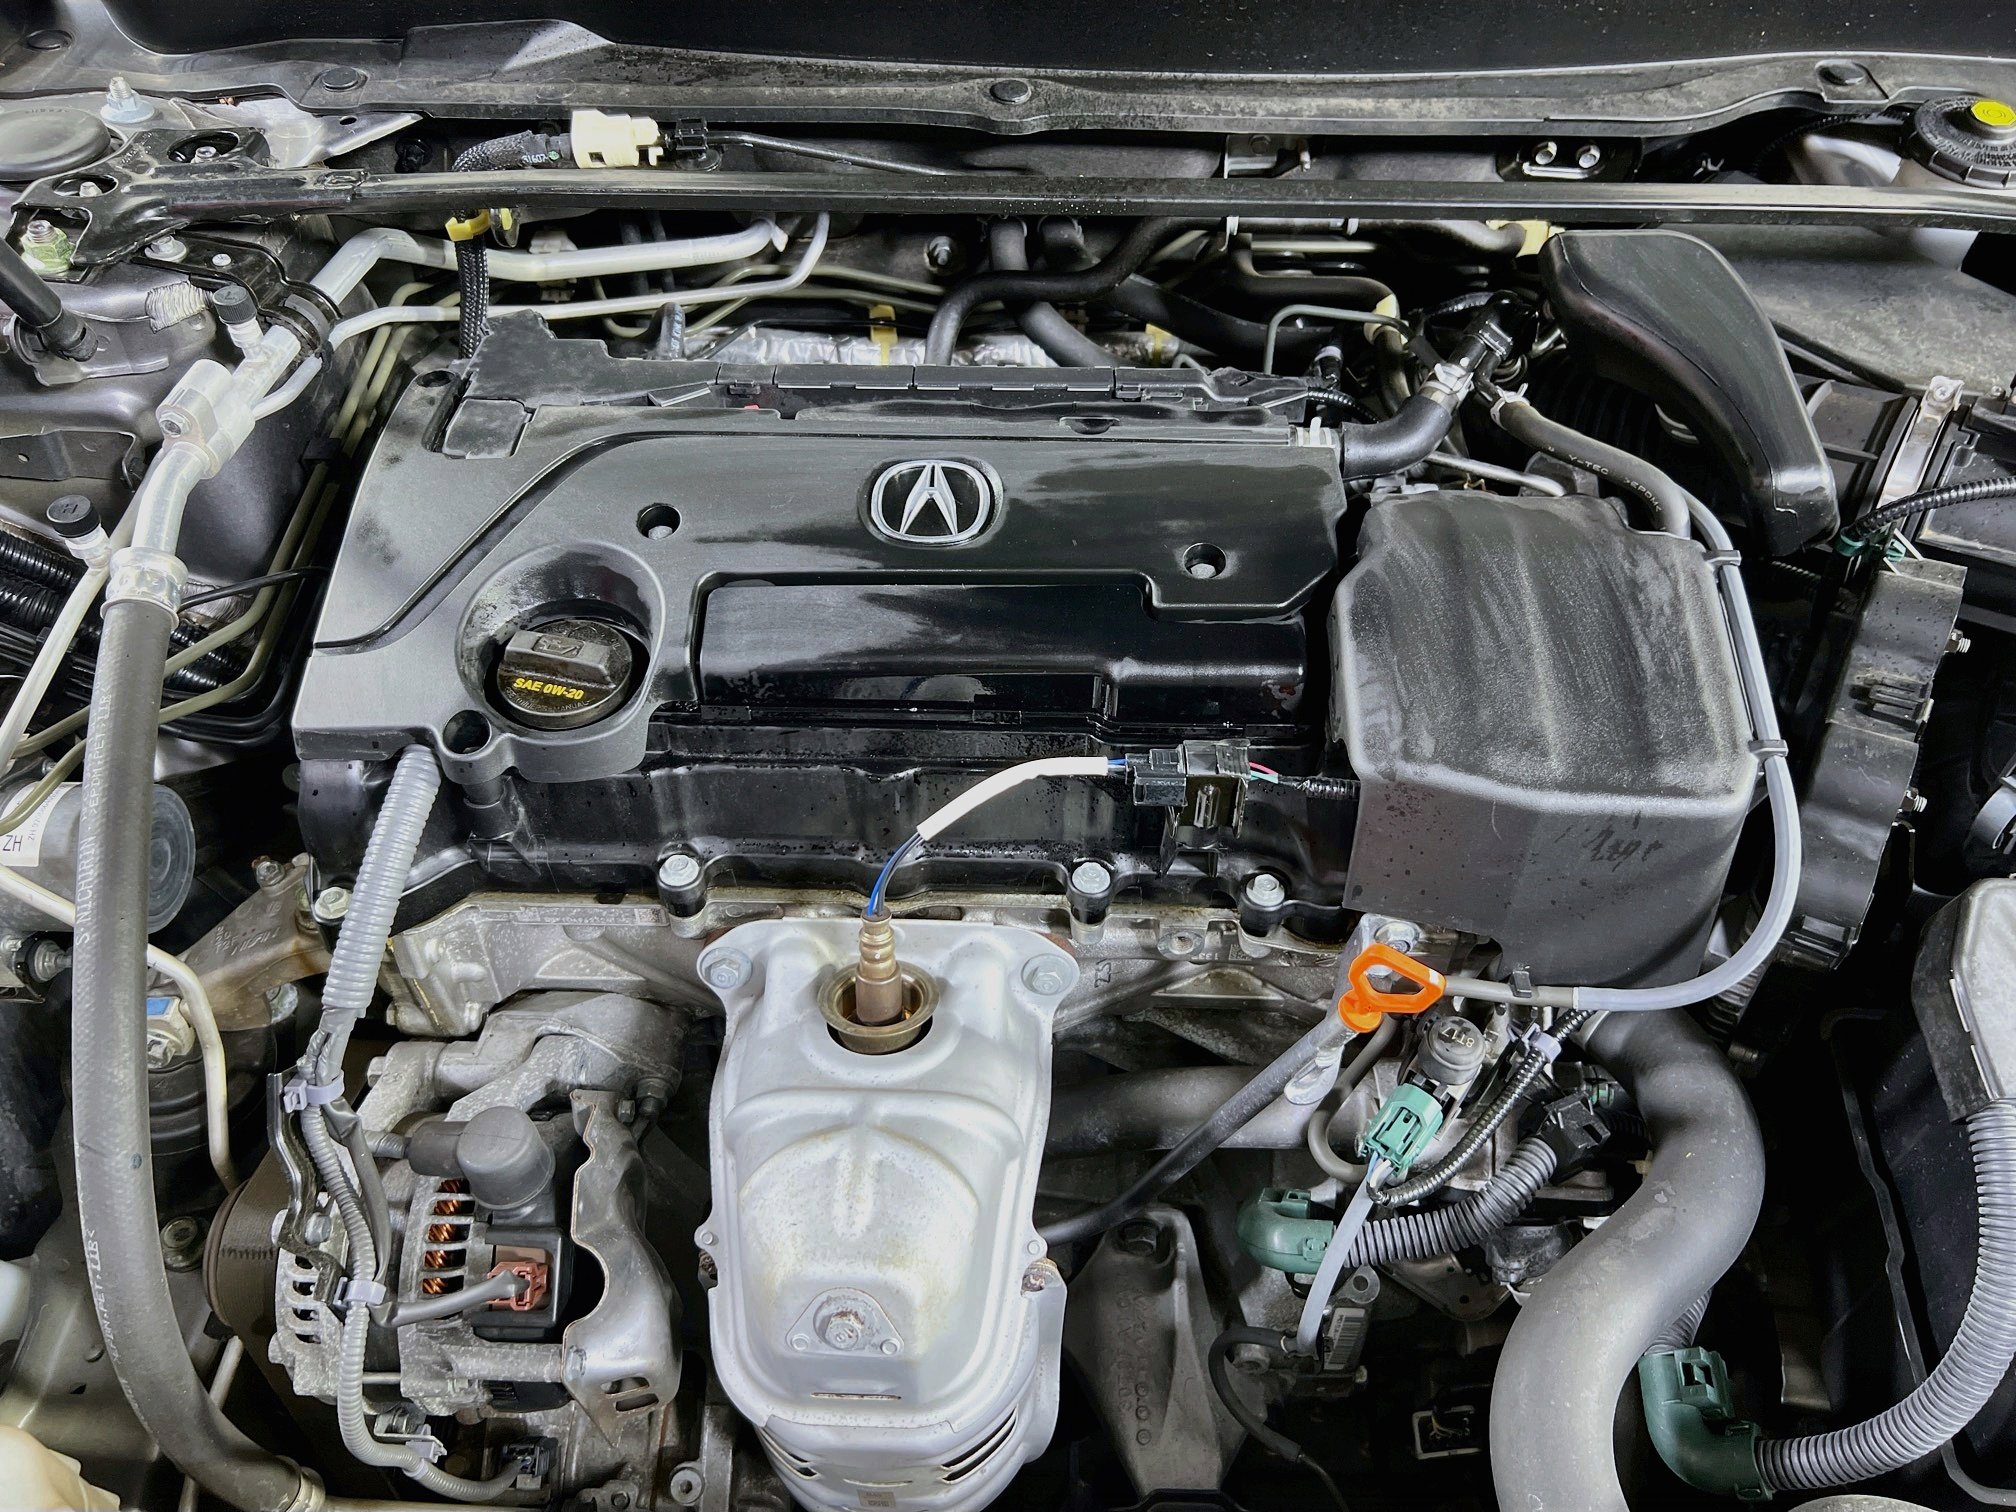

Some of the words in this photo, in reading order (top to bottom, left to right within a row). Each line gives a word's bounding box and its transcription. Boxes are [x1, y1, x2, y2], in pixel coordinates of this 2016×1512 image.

[513, 677, 543, 692] SAE
[543, 684, 585, 700] 0W-20
[2, 834, 23, 852] ZH
